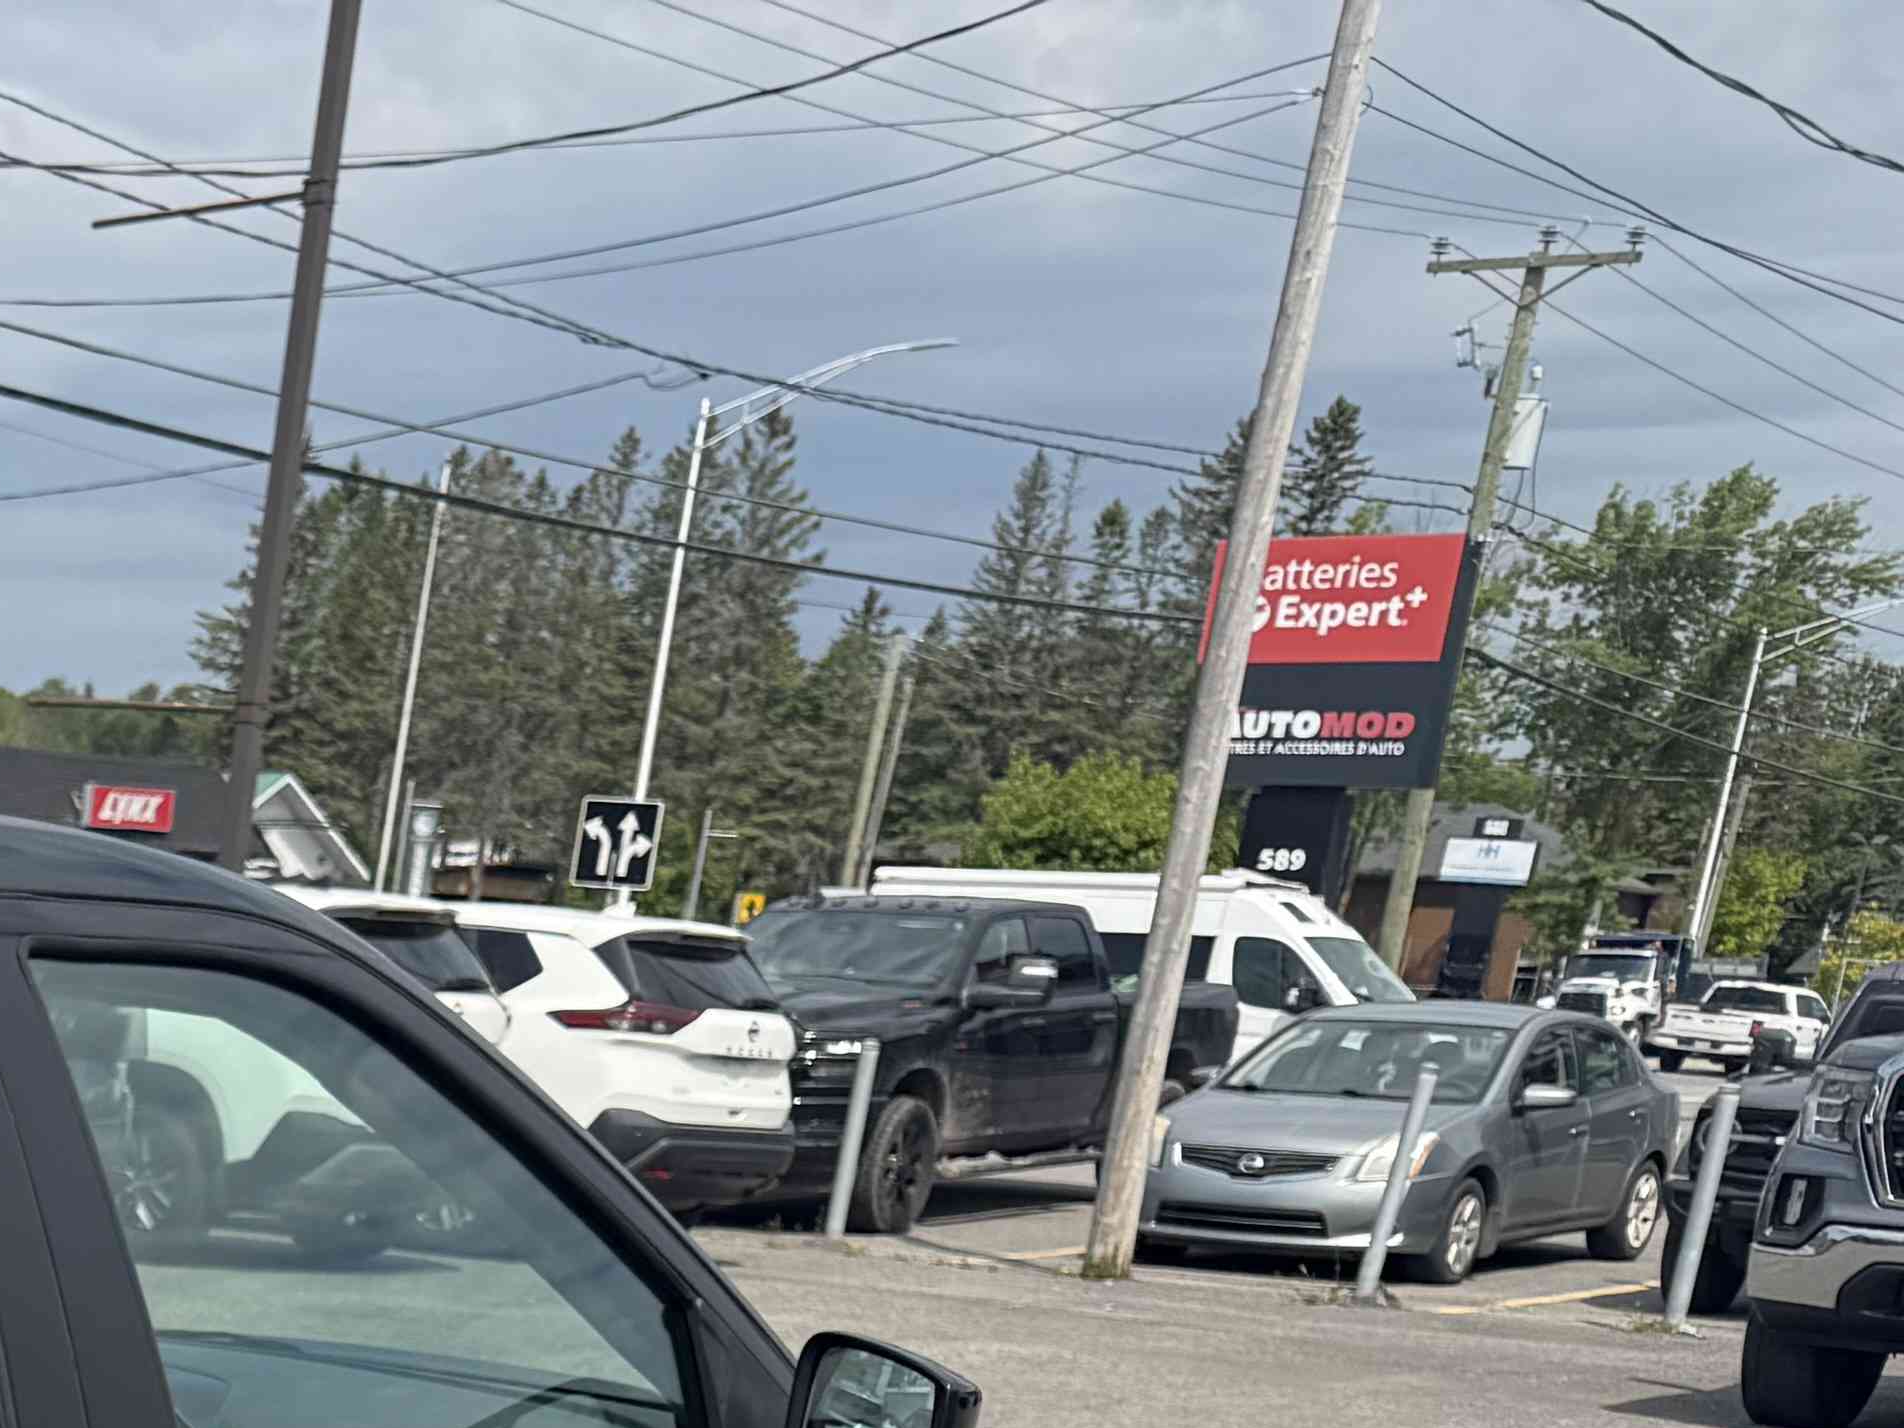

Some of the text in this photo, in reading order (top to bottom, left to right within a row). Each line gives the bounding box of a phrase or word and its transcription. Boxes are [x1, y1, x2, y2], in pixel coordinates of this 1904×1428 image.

[1264, 555, 1400, 591] atteries
[1229, 741, 1256, 756] TRES
[1273, 741, 1355, 756] ACCESSOIRES
[1256, 847, 1307, 872] 589
